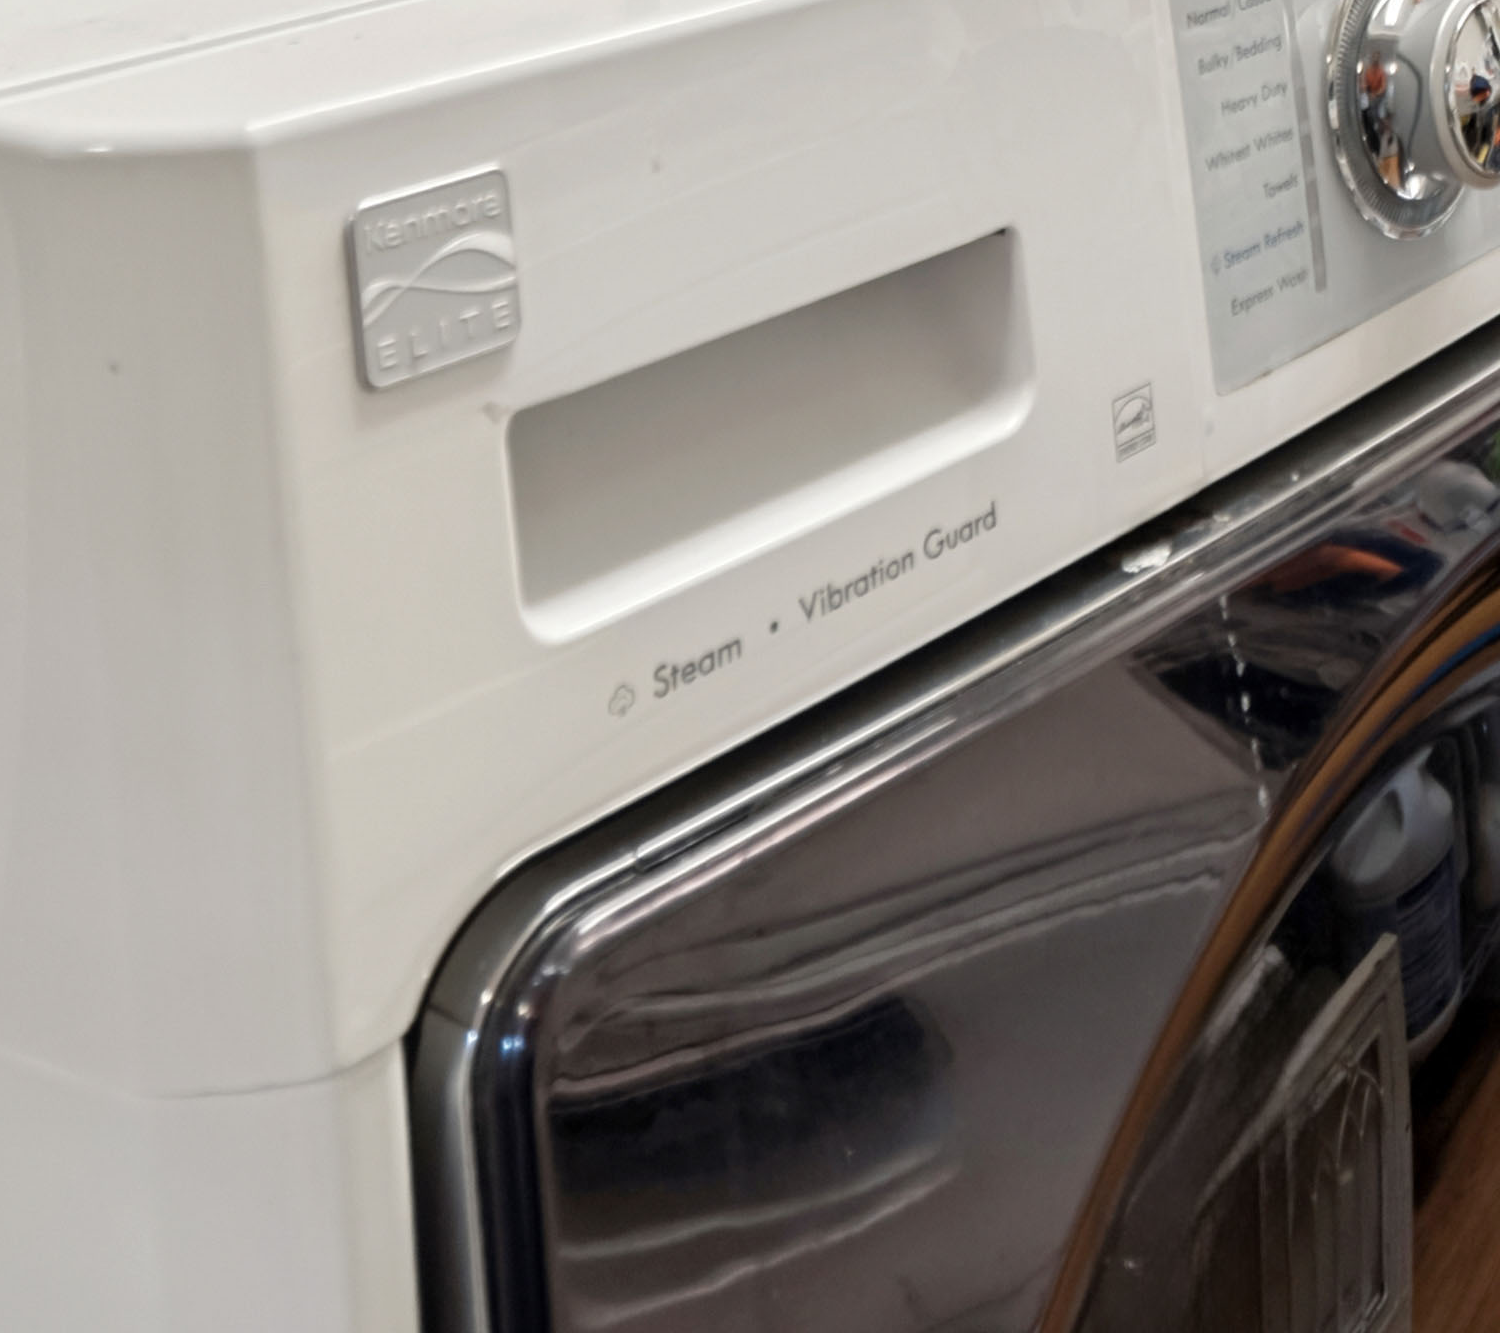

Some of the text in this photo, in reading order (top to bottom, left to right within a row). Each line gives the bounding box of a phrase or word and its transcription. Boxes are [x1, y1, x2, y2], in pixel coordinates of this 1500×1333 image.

[1220, 82, 1288, 116] Heavy Duty
[364, 193, 501, 255] Kenmore
[1224, 220, 1305, 270] Steam Refresh
[1230, 285, 1274, 318] Express
[376, 299, 511, 372] ELITE
[653, 500, 998, 700] Steam Vibration Guard
